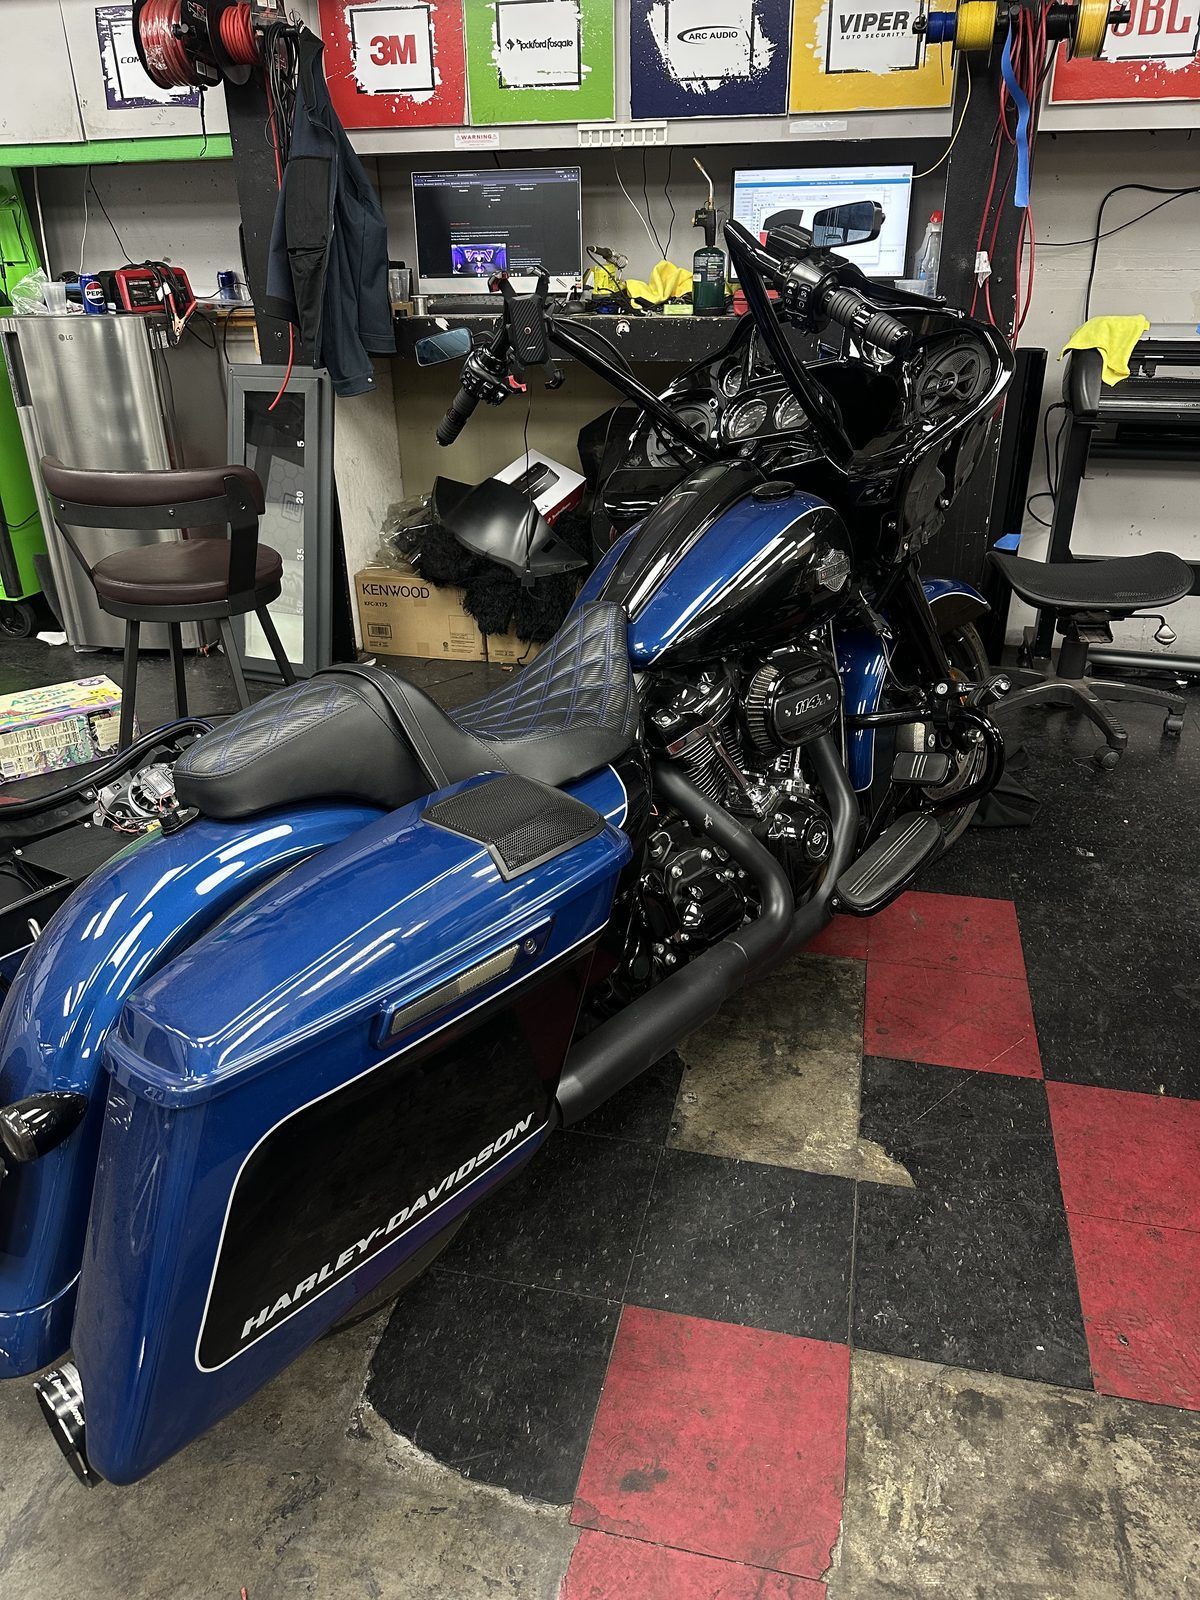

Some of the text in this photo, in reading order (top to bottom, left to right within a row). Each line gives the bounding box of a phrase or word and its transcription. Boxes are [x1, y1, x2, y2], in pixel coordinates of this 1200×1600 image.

[840, 11, 910, 33] VIPER
[689, 31, 738, 40] ARC AUDIO
[865, 31, 906, 39] SECURITY
[370, 34, 418, 66] 3M
[296, 440, 305, 448] 5
[296, 490, 305, 504] 20
[296, 548, 305, 561] 35
[362, 583, 430, 599] KENWOOD
[240, 1111, 534, 1339] HARLEY-DAVIDSON
